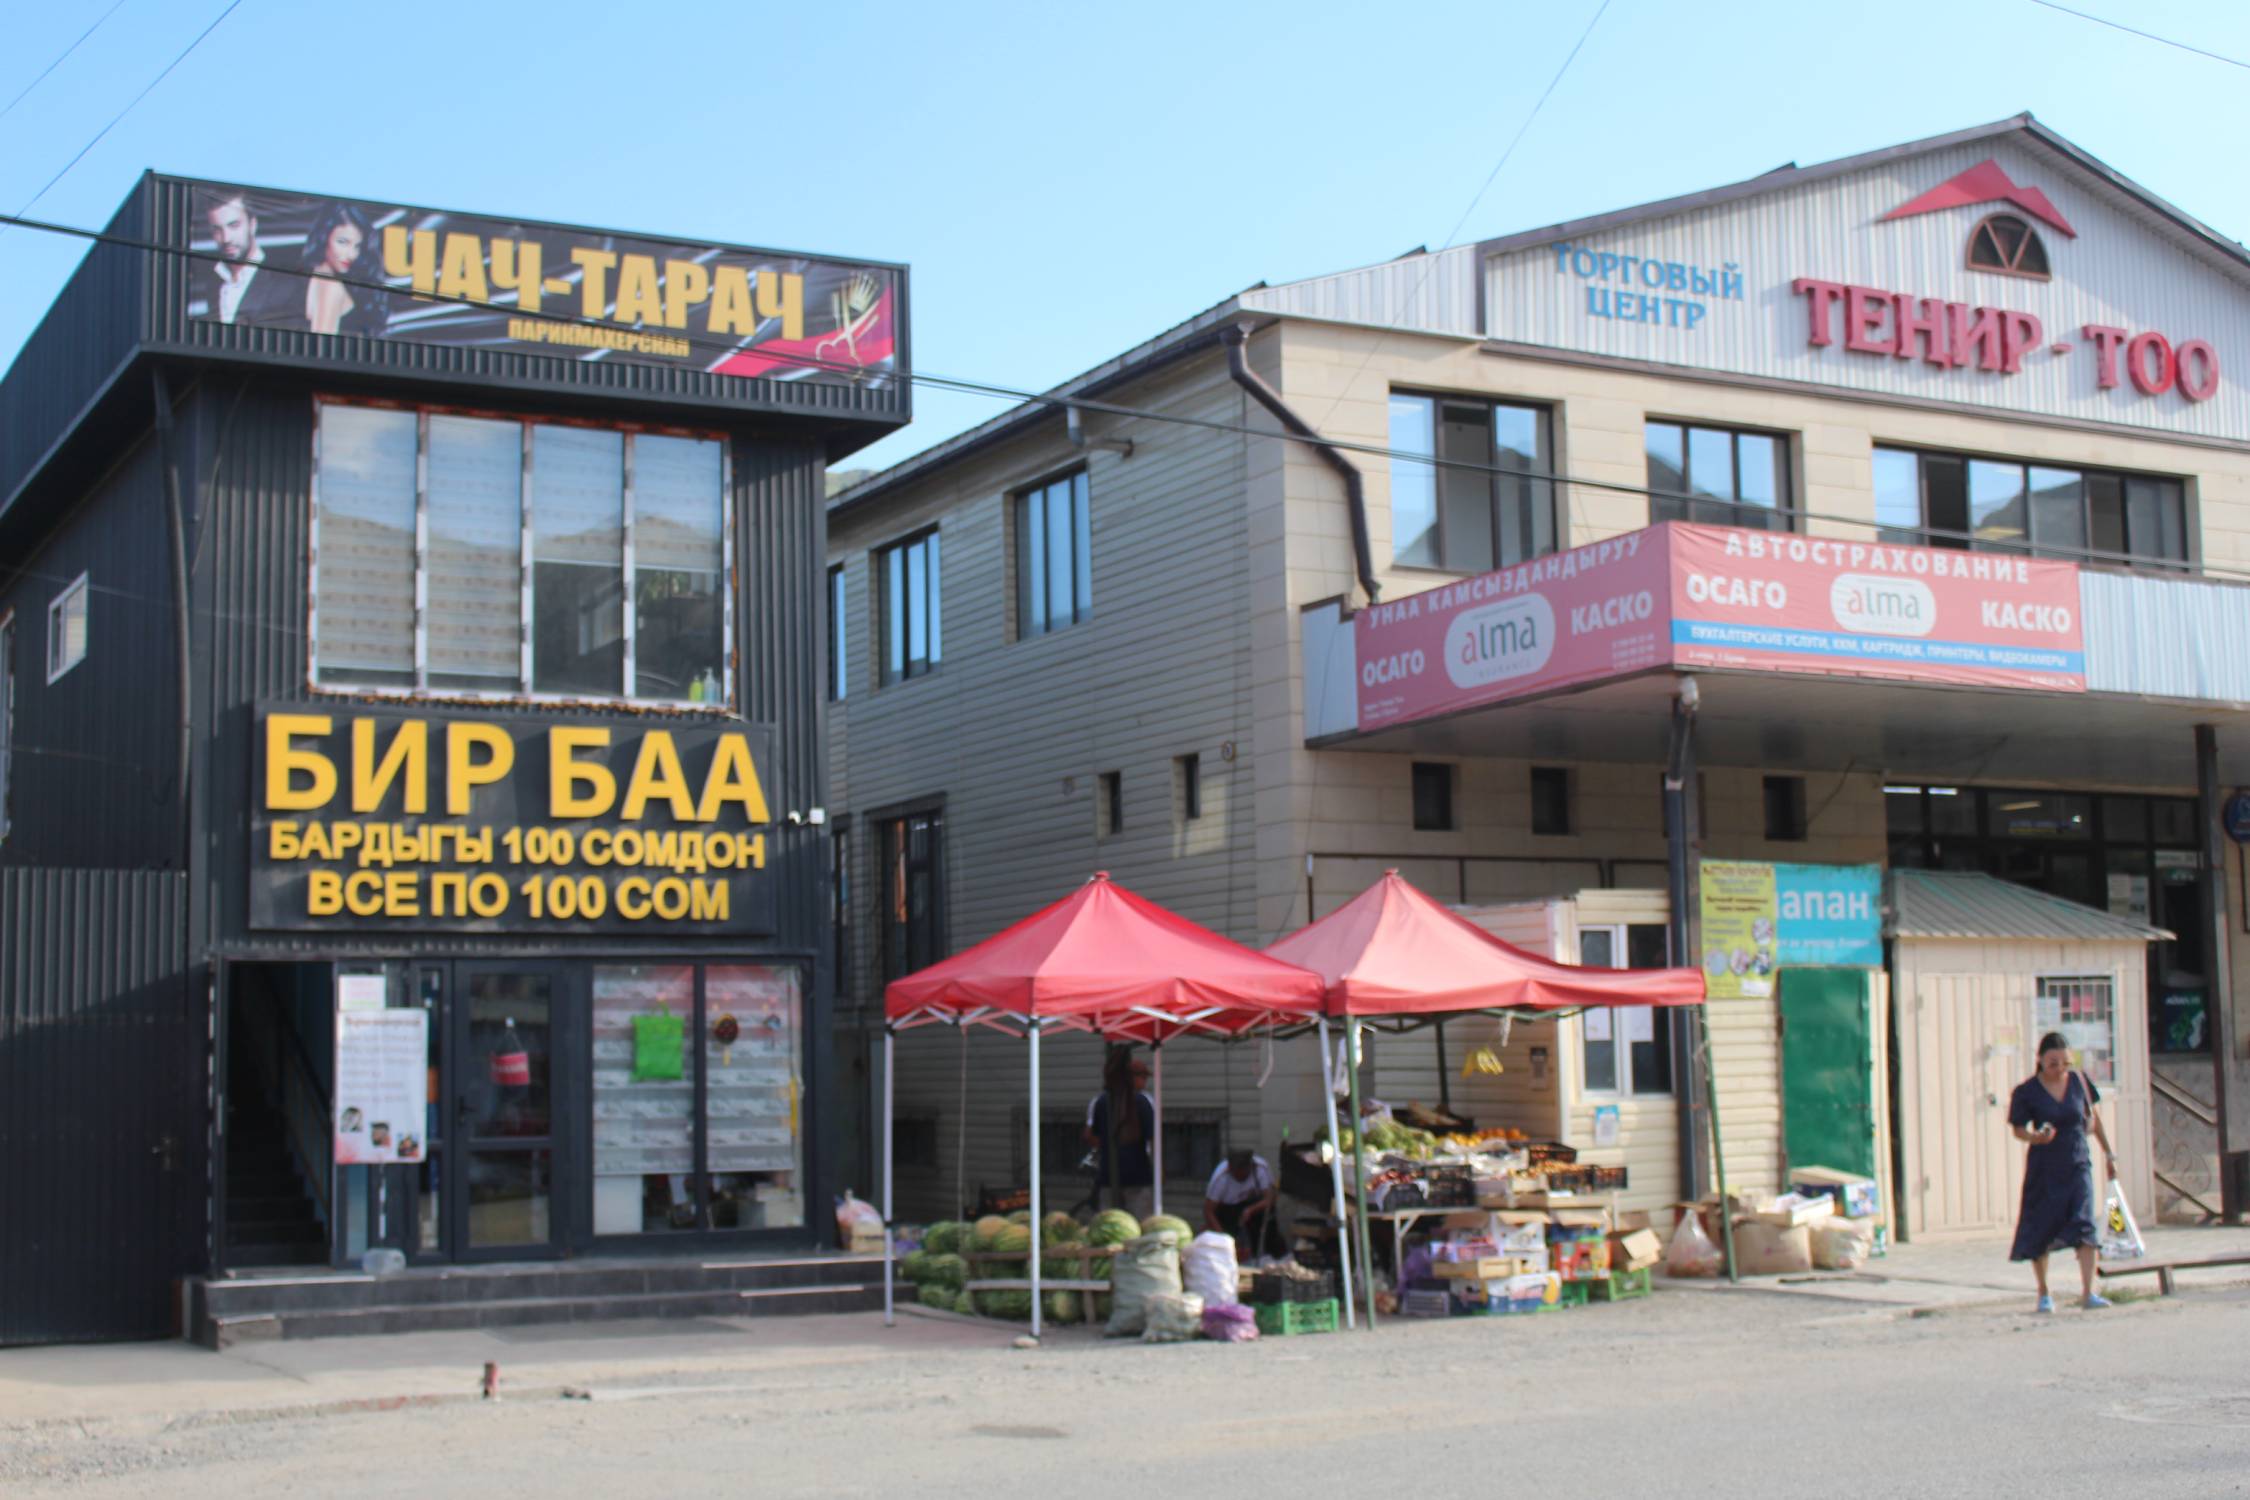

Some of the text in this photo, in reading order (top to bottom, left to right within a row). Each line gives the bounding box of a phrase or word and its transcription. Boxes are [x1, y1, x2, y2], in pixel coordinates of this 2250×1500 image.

[382, 226, 802, 341] ЧАЧ-ТАРАЧ
[1551, 242, 1744, 301] ТОРГОВЫЙ
[1586, 286, 1707, 329] ЦЕНТР
[2083, 323, 2219, 403] ТОО
[1369, 534, 1641, 629] УНАА КАМСЫЗДАНДЫРУУ
[1725, 532, 2029, 584] АВТОСТРАХОВАНИЕ
[1571, 590, 1654, 635] КАСКО
[1686, 573, 1788, 609] ОСАГО
[1847, 586, 1921, 620] alma
[1461, 616, 1537, 665] alma
[1981, 600, 2072, 634] КАСКО
[1363, 648, 1425, 688] ОСАГО
[265, 713, 771, 823] БИР БАА
[269, 820, 765, 873] БАРДЫГЫ 100 СОМДОН
[307, 870, 729, 921] ВСЕ ПО 100 СОМ
[1776, 891, 1869, 920] апан
